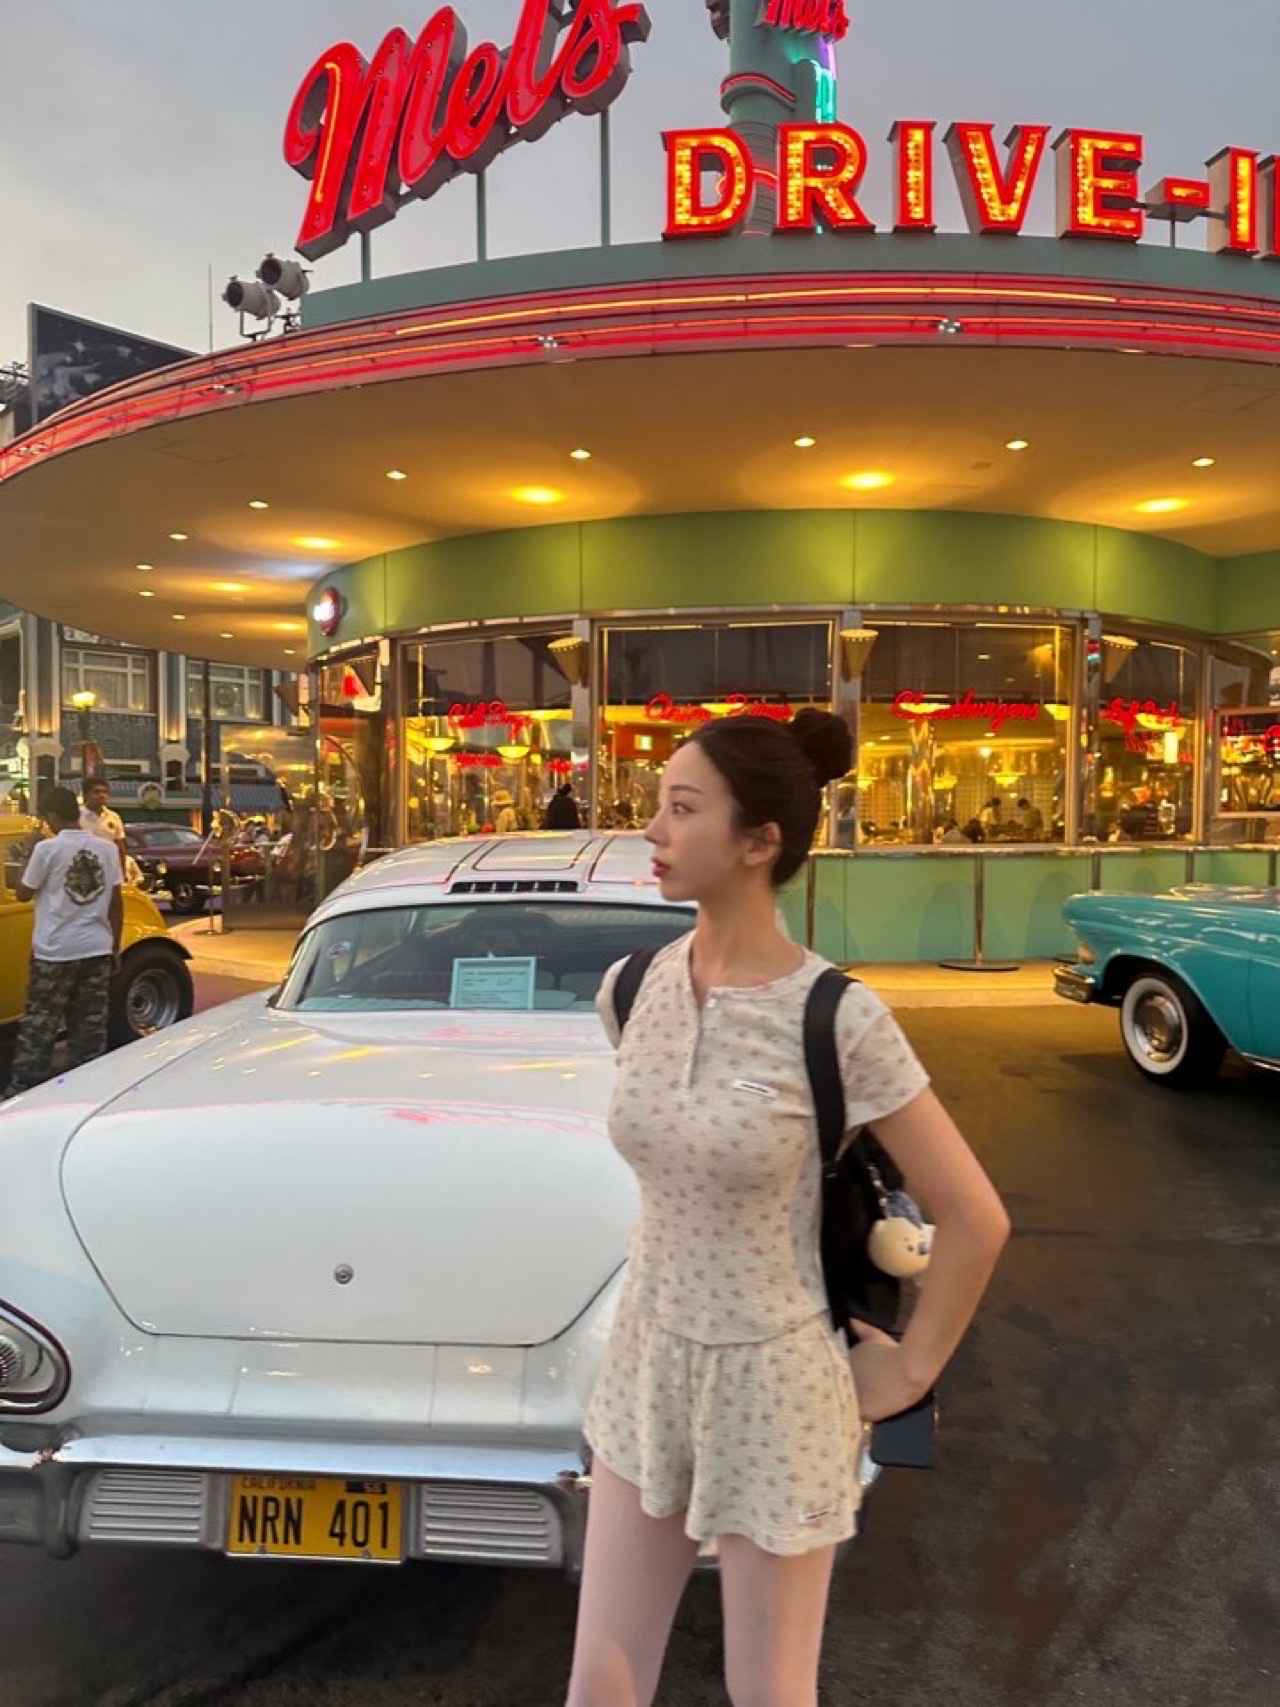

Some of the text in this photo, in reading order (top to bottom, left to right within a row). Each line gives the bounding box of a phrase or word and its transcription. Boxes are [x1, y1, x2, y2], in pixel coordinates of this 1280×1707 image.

[662, 121, 1280, 258] DRIVE-I
[238, 1495, 389, 1549] NRN 401
